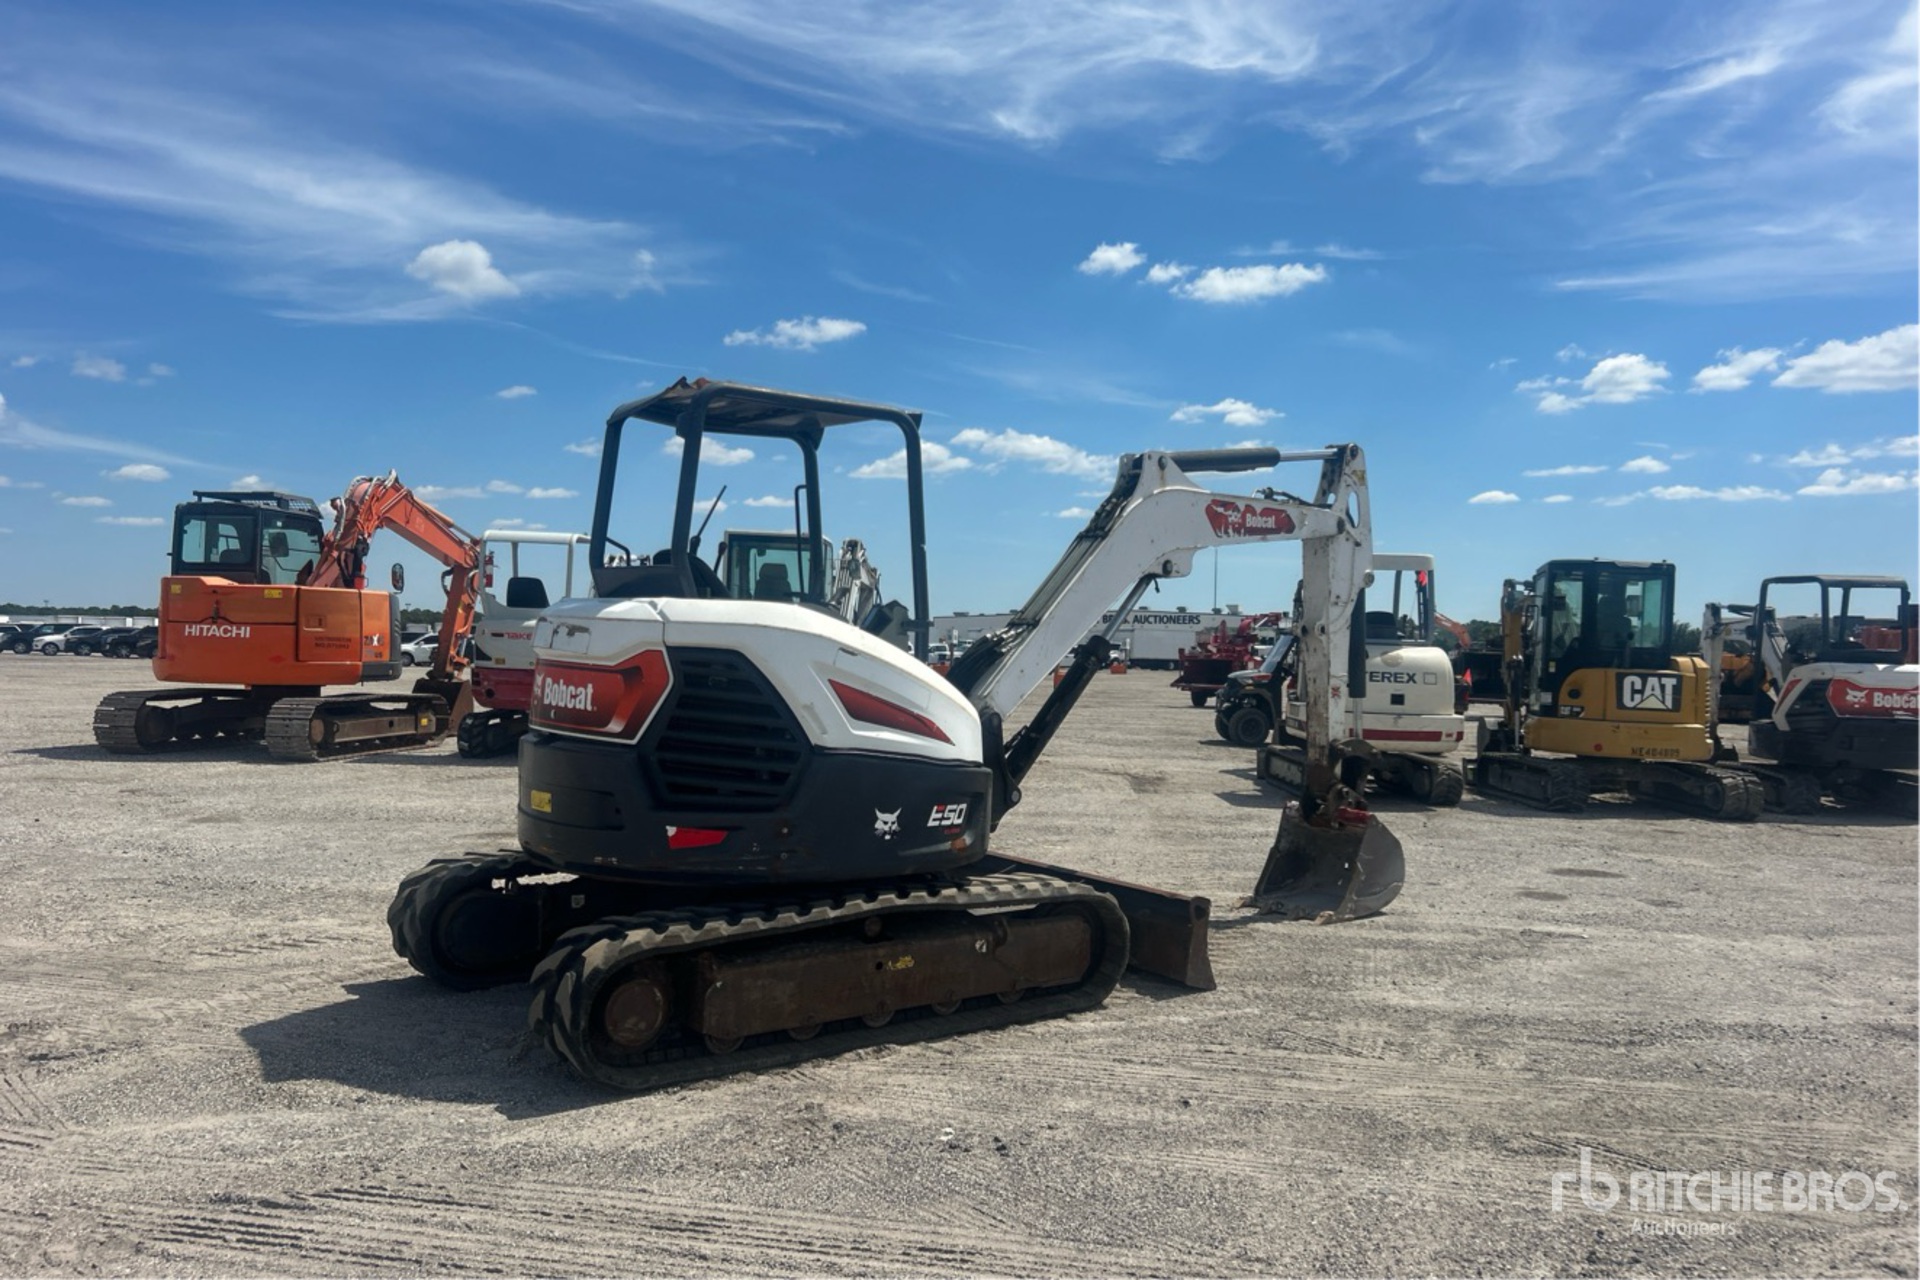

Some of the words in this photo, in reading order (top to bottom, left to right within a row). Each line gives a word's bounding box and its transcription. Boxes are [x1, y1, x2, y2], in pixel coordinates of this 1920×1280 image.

[1246, 513, 1276, 528] Bobcat
[1133, 614, 1201, 625] AUCTIONEERS
[185, 624, 251, 638] HITACHI
[543, 677, 594, 711] Bobcat
[1622, 675, 1677, 710] CAT
[1872, 691, 1918, 709] Bobca
[926, 803, 968, 827] E50
